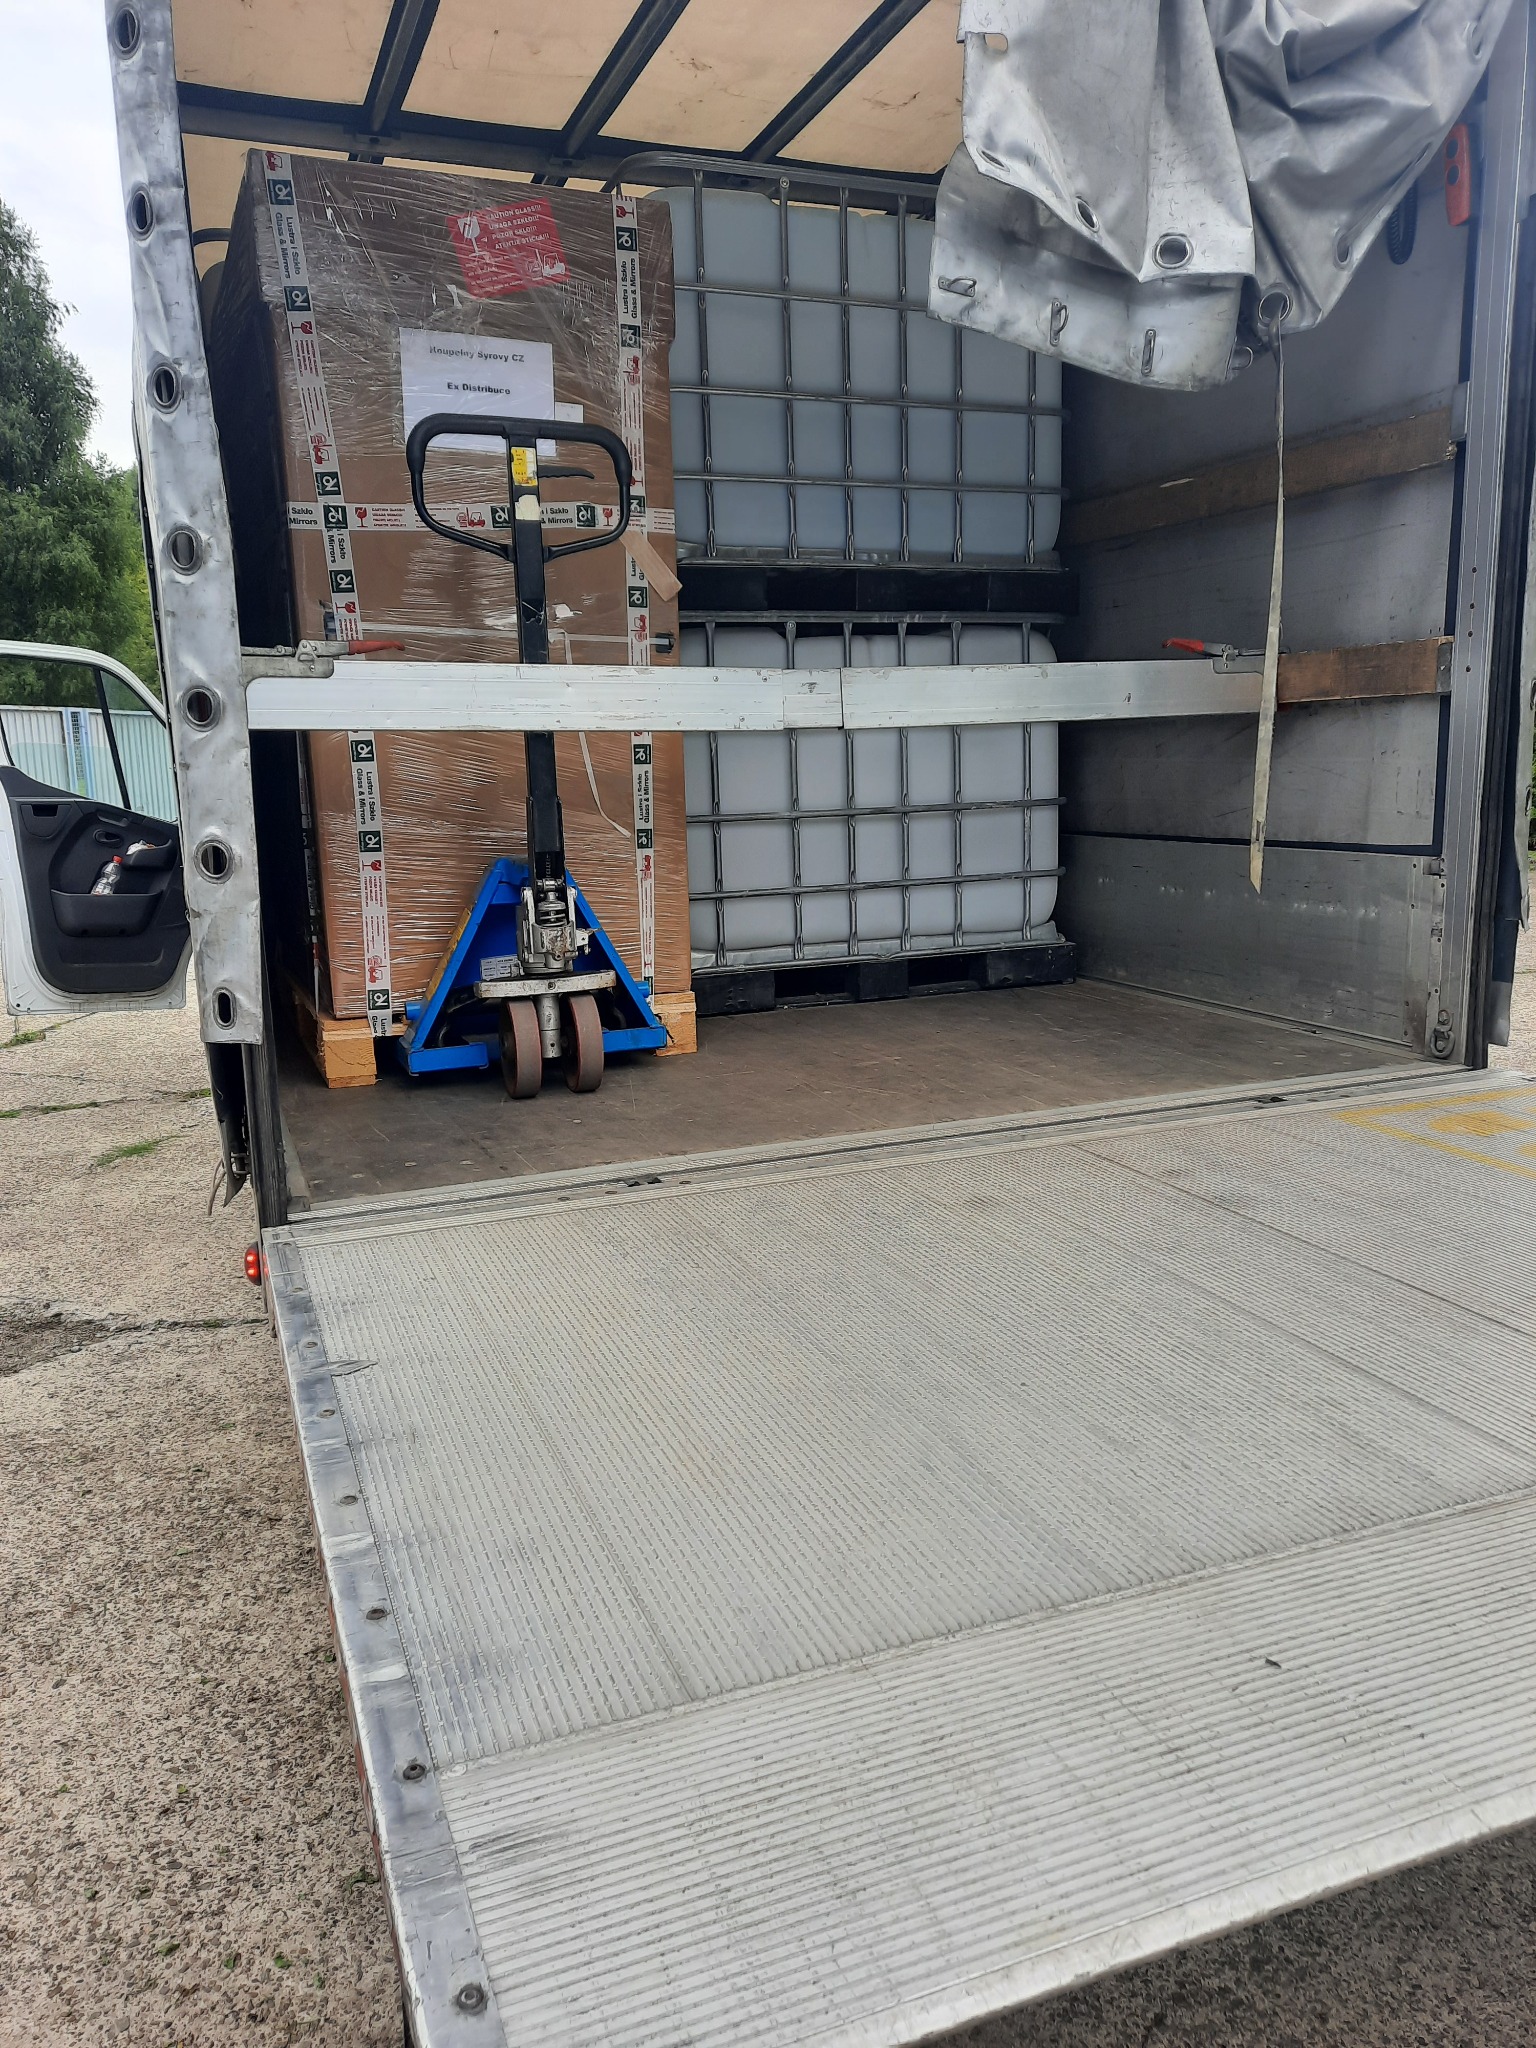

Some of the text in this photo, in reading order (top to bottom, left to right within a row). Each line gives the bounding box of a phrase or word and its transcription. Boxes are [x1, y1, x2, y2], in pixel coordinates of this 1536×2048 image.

[275, 212, 283, 236] Glass
[281, 247, 290, 278] Mirrors
[477, 351, 509, 362] Syrovy
[511, 353, 525, 362] CZ
[447, 382, 459, 390] Ex
[289, 517, 318, 525] Mirrors
[327, 534, 337, 564] Mirrors
